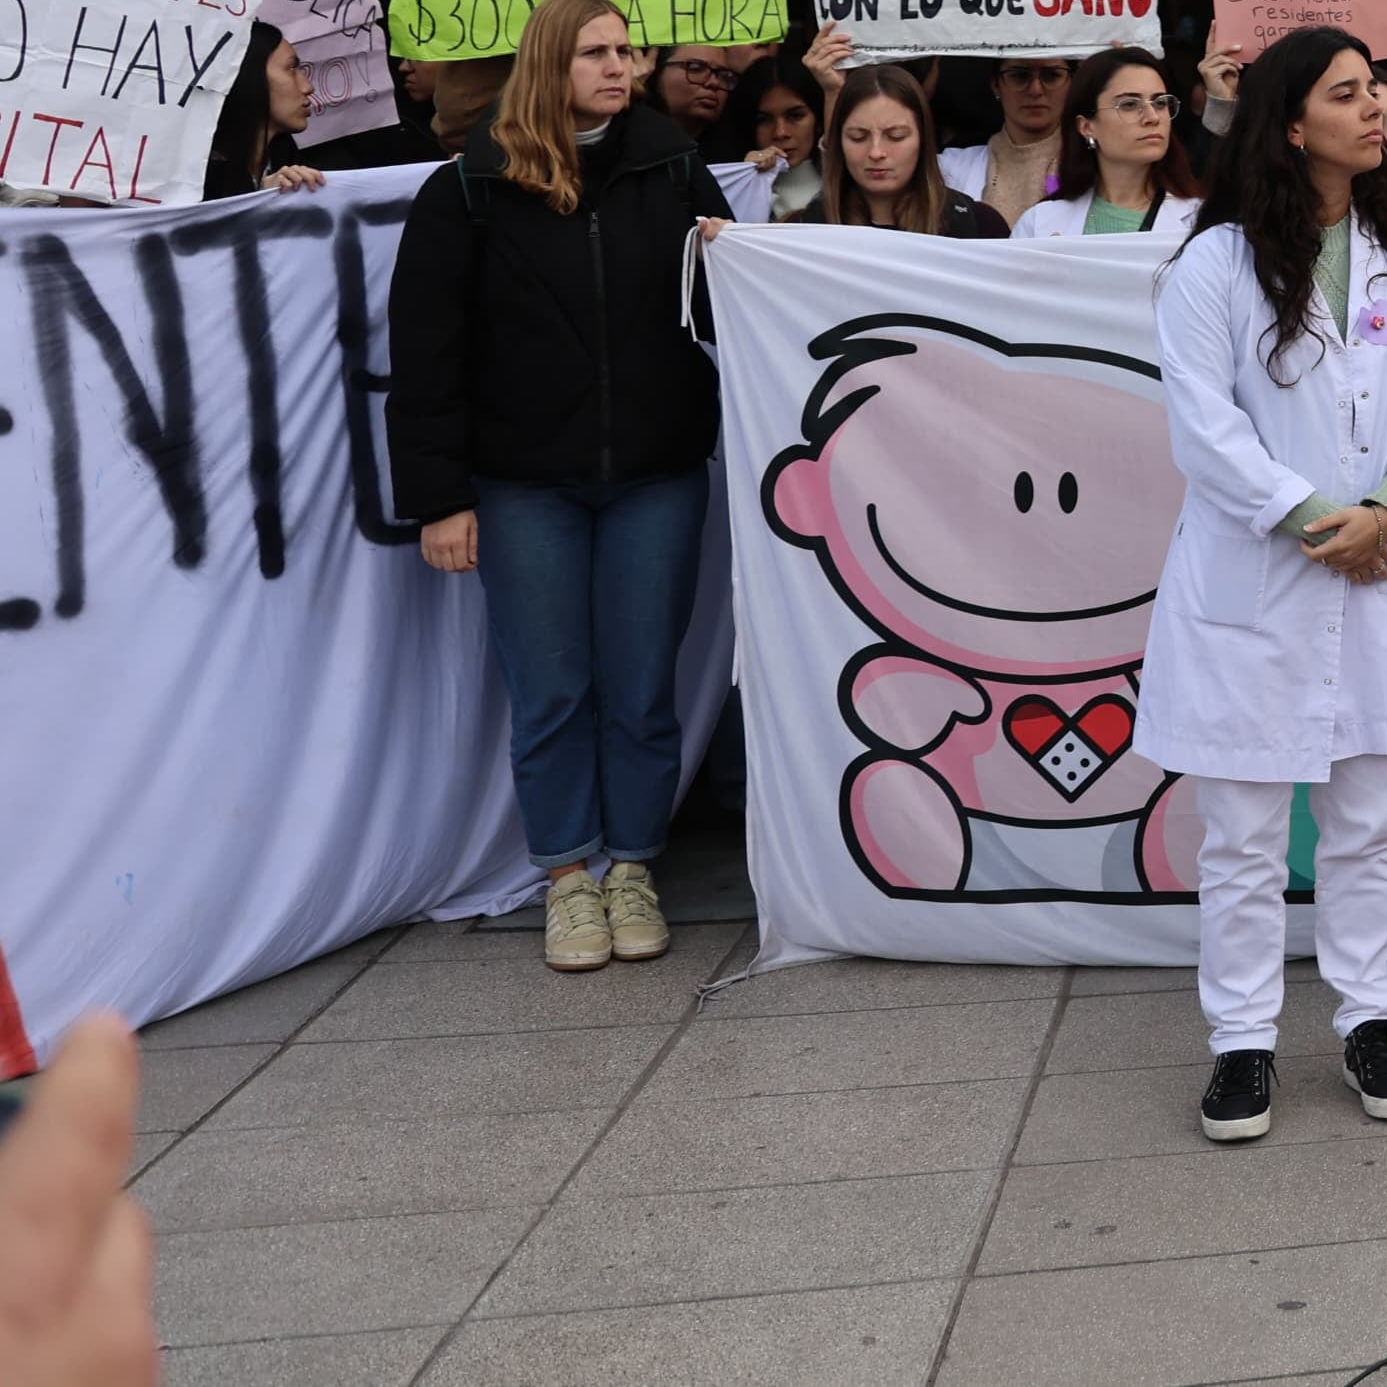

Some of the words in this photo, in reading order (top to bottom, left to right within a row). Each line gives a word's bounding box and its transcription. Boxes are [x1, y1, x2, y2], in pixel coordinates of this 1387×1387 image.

[62, 6, 234, 108] HAY
[1251, 3, 1353, 23] residentes
[0, 197, 423, 632] NTE
